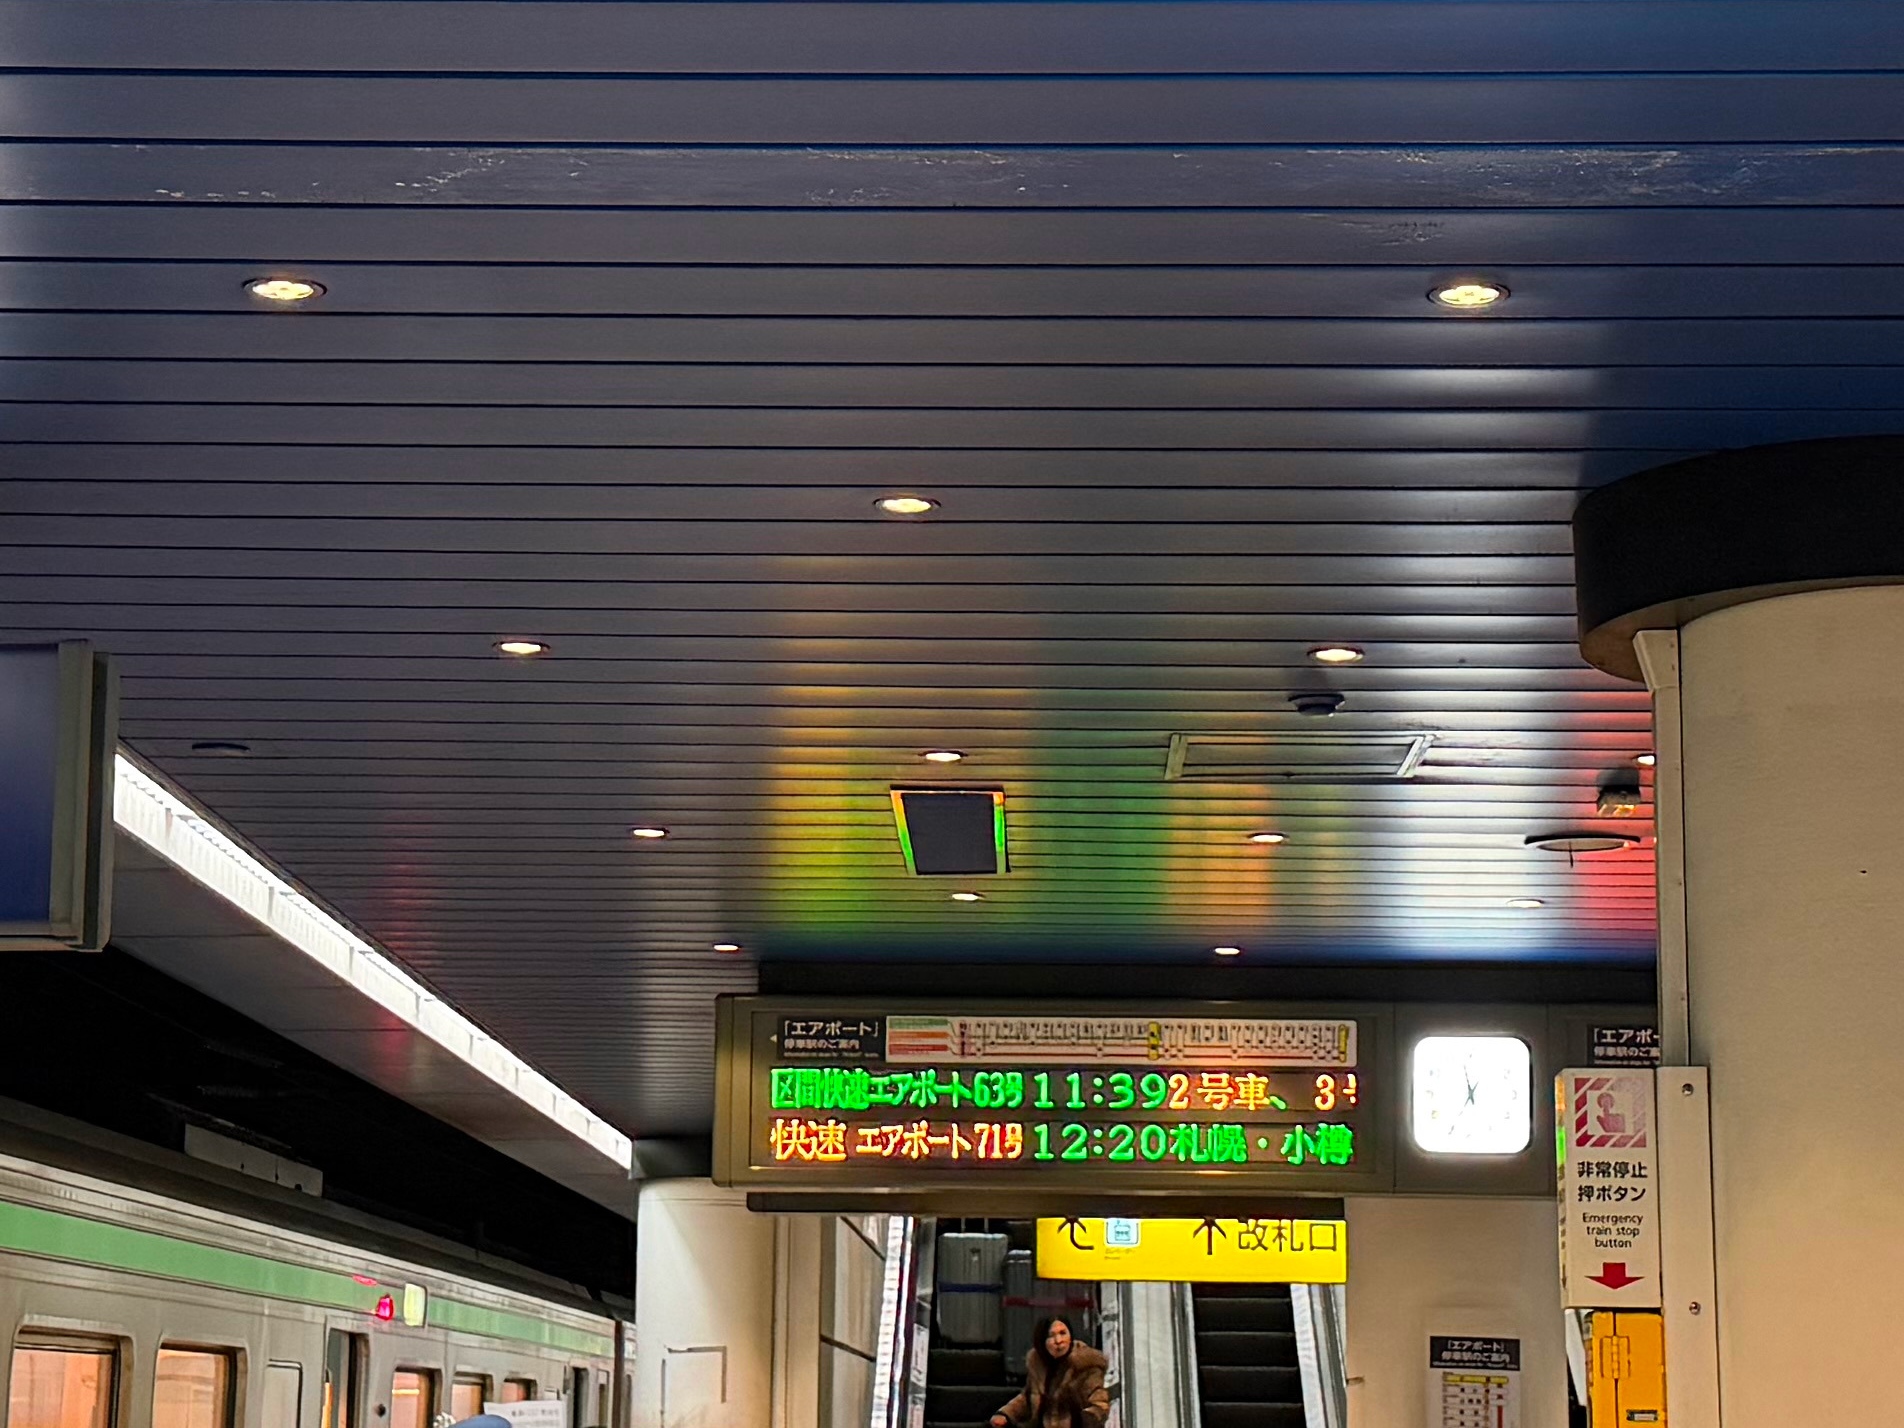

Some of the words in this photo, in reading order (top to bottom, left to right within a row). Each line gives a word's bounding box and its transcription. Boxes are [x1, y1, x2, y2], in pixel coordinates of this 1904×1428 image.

[1033, 1072, 1167, 1110] 11:39
[770, 1119, 846, 1161] 快速
[1033, 1123, 1167, 1161] 12:20
[1170, 1123, 1354, 1164] 札幌・小樽
[1577, 1161, 1648, 1179] 非常停止
[1577, 1185, 1646, 1202] 押ボタン
[1582, 1212, 1643, 1226] Emergency
[1238, 1220, 1337, 1252] 改札口
[1587, 1225, 1612, 1237] train
[1616, 1225, 1640, 1240] stop
[1595, 1238, 1632, 1249] button
